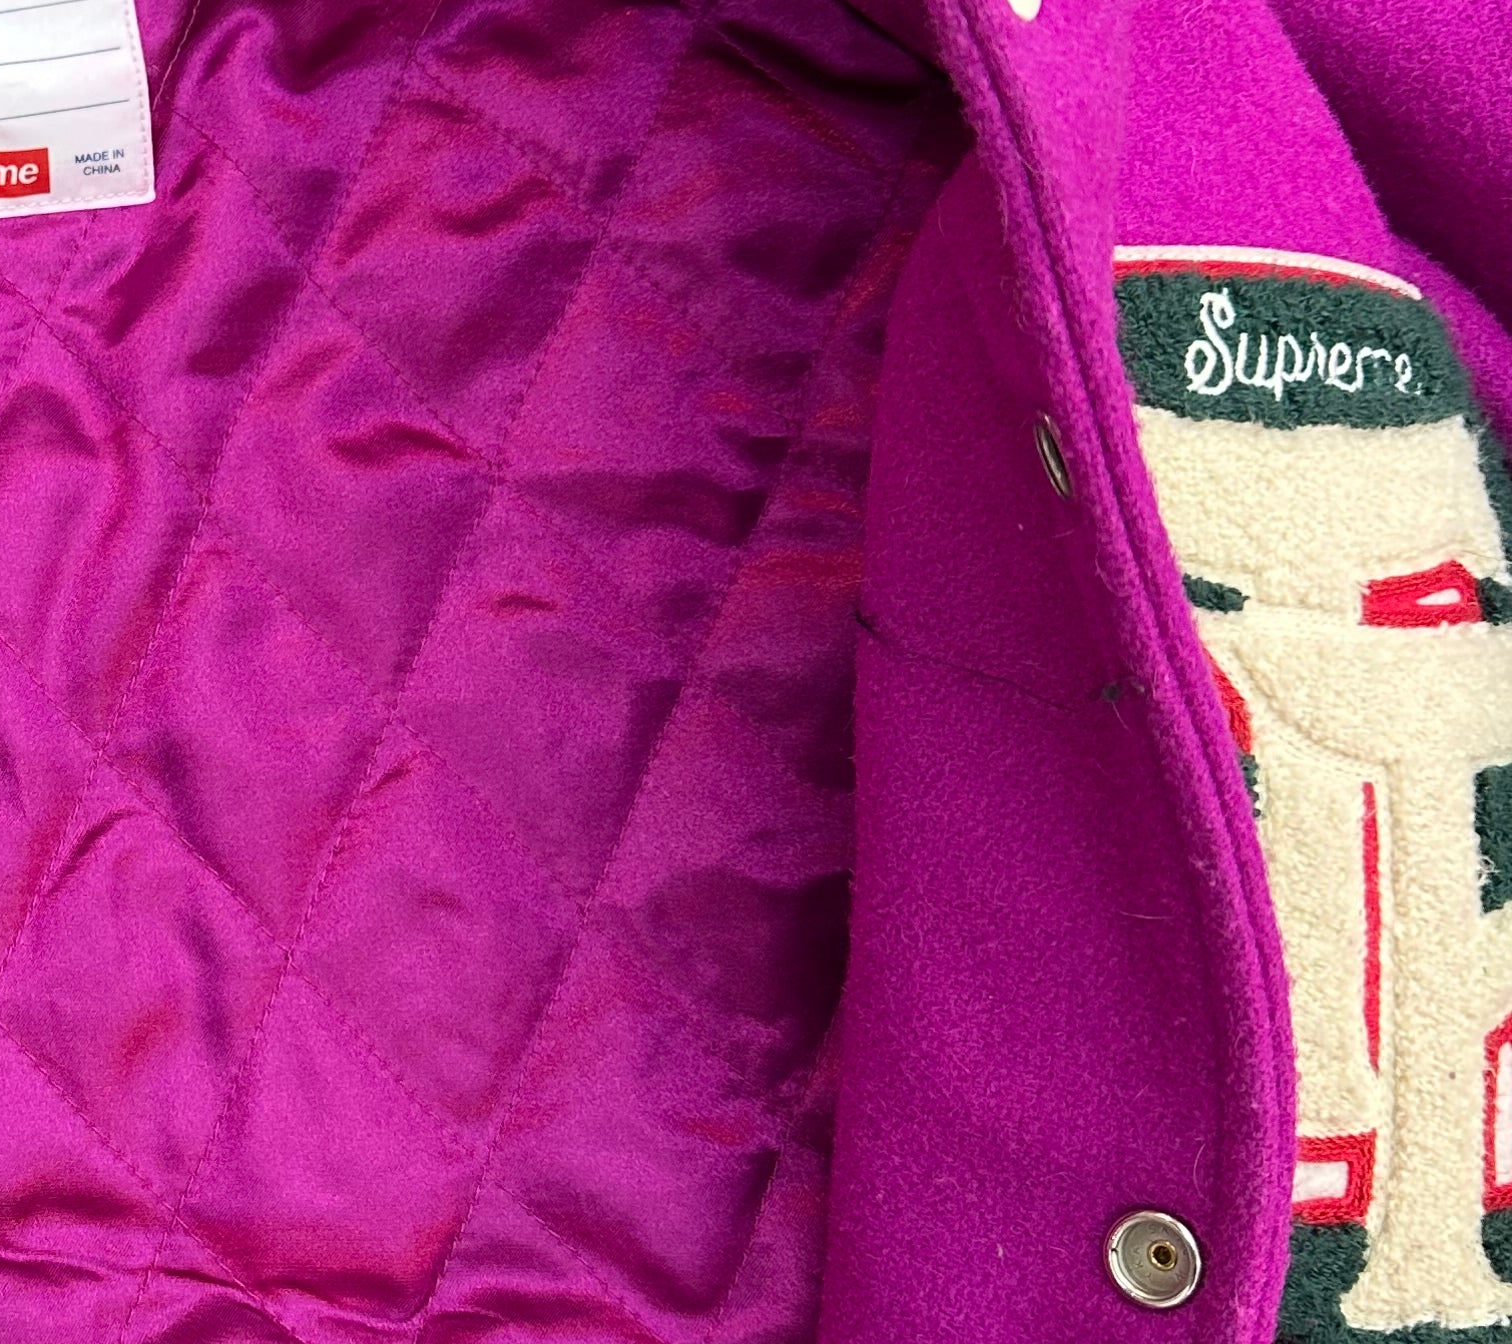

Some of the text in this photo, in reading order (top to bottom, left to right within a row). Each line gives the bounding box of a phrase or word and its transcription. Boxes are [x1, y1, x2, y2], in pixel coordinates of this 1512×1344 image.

[75, 149, 124, 163] MADE IN
[83, 164, 120, 175] CHINA
